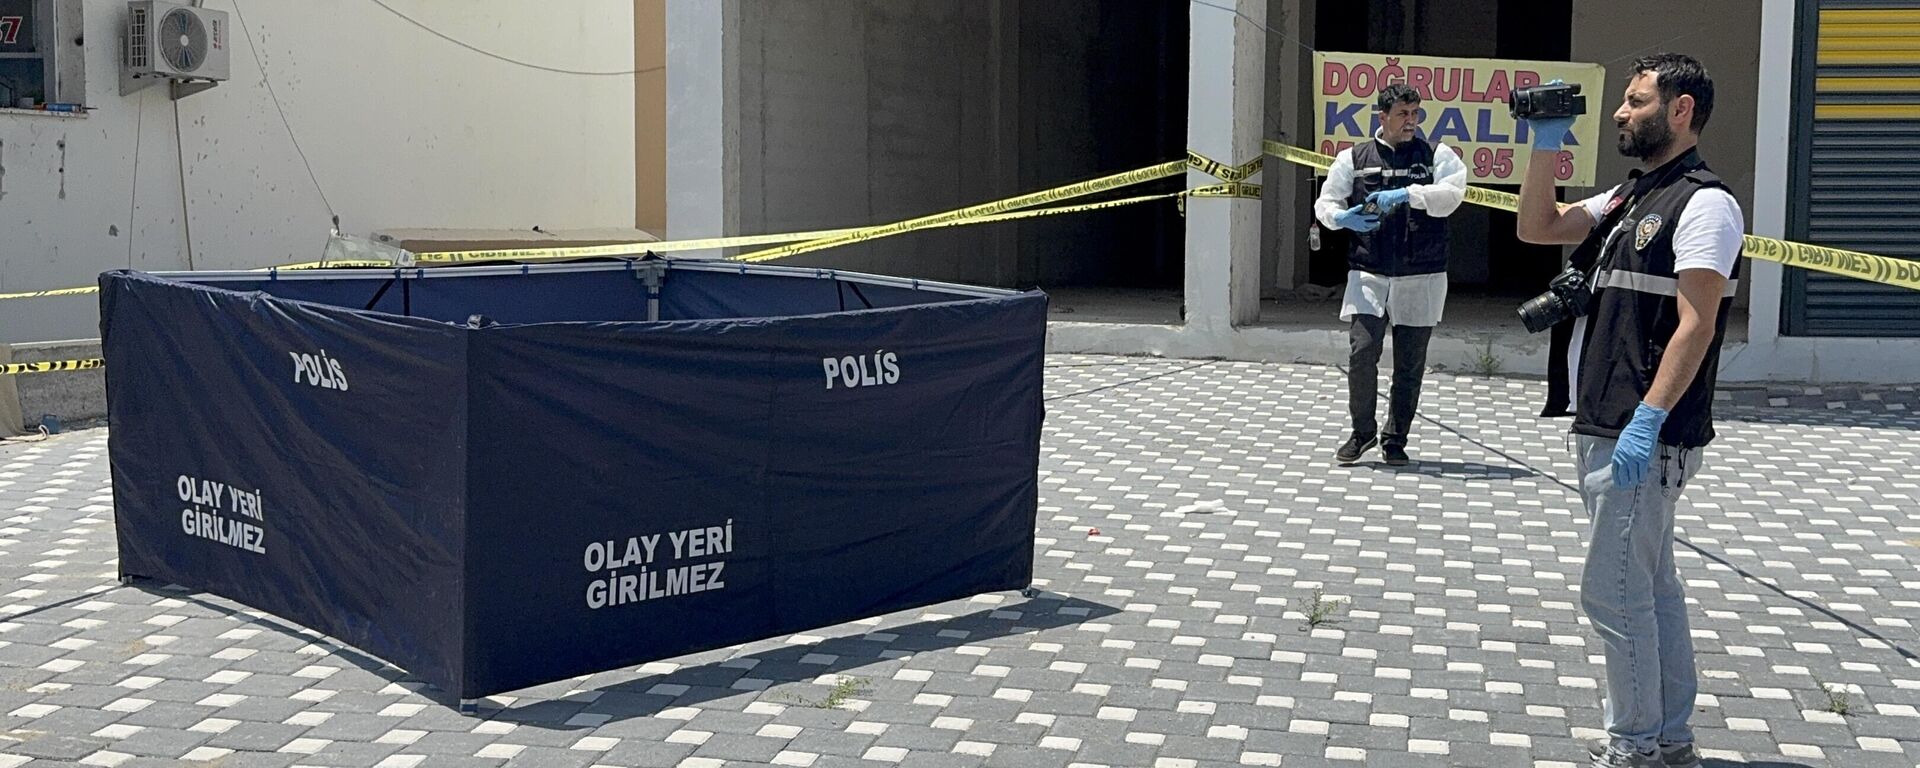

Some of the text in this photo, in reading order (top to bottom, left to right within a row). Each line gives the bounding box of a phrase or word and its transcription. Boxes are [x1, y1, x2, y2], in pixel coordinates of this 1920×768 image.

[0, 16, 23, 44] 7
[1324, 101, 1579, 146] KİALI
[1473, 147, 1514, 178] 95
[289, 349, 348, 391] POLİS
[823, 349, 900, 389] POLİS
[177, 474, 264, 521] OLAY YERİ
[182, 504, 266, 555] GİRİLMEZ
[584, 518, 733, 572] OLAY YERİ
[586, 561, 725, 610] GİRİLMEZ
